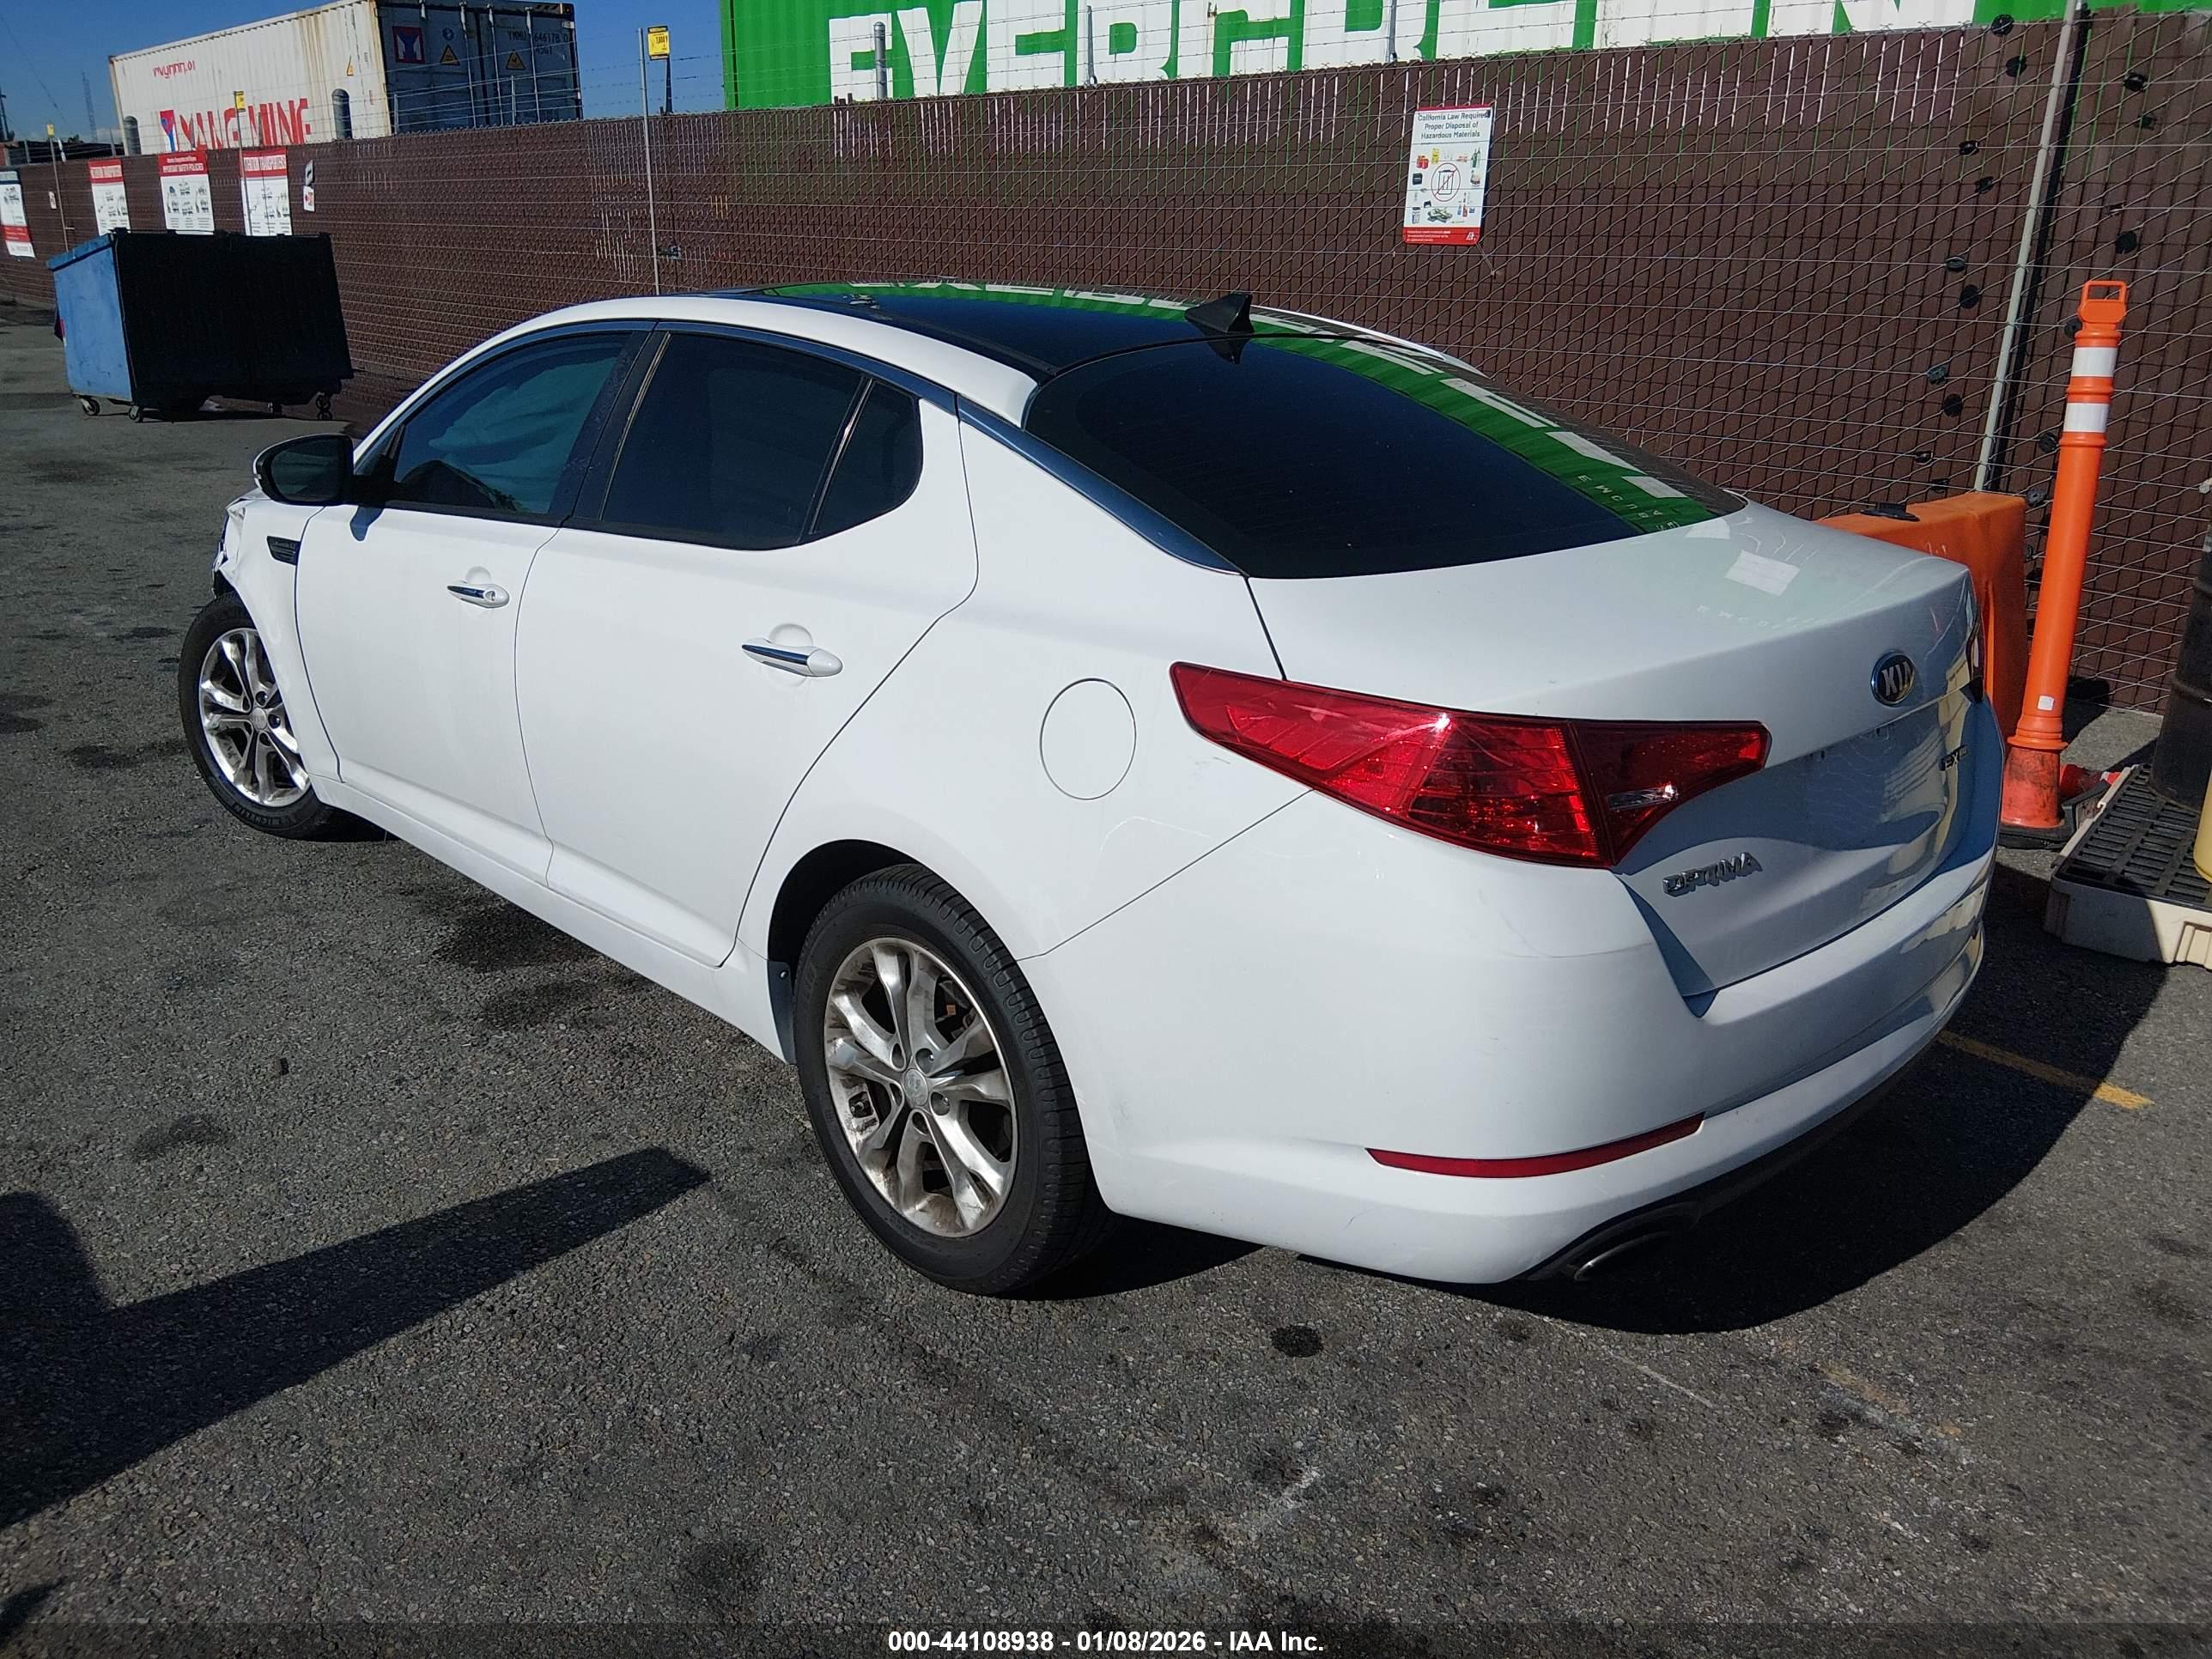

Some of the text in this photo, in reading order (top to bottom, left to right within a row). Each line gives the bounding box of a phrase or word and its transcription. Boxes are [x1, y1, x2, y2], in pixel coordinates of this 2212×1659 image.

[1418, 112, 1446, 121] California
[1881, 660, 1916, 697] KIA
[1662, 852, 1763, 896] OPTIMA
